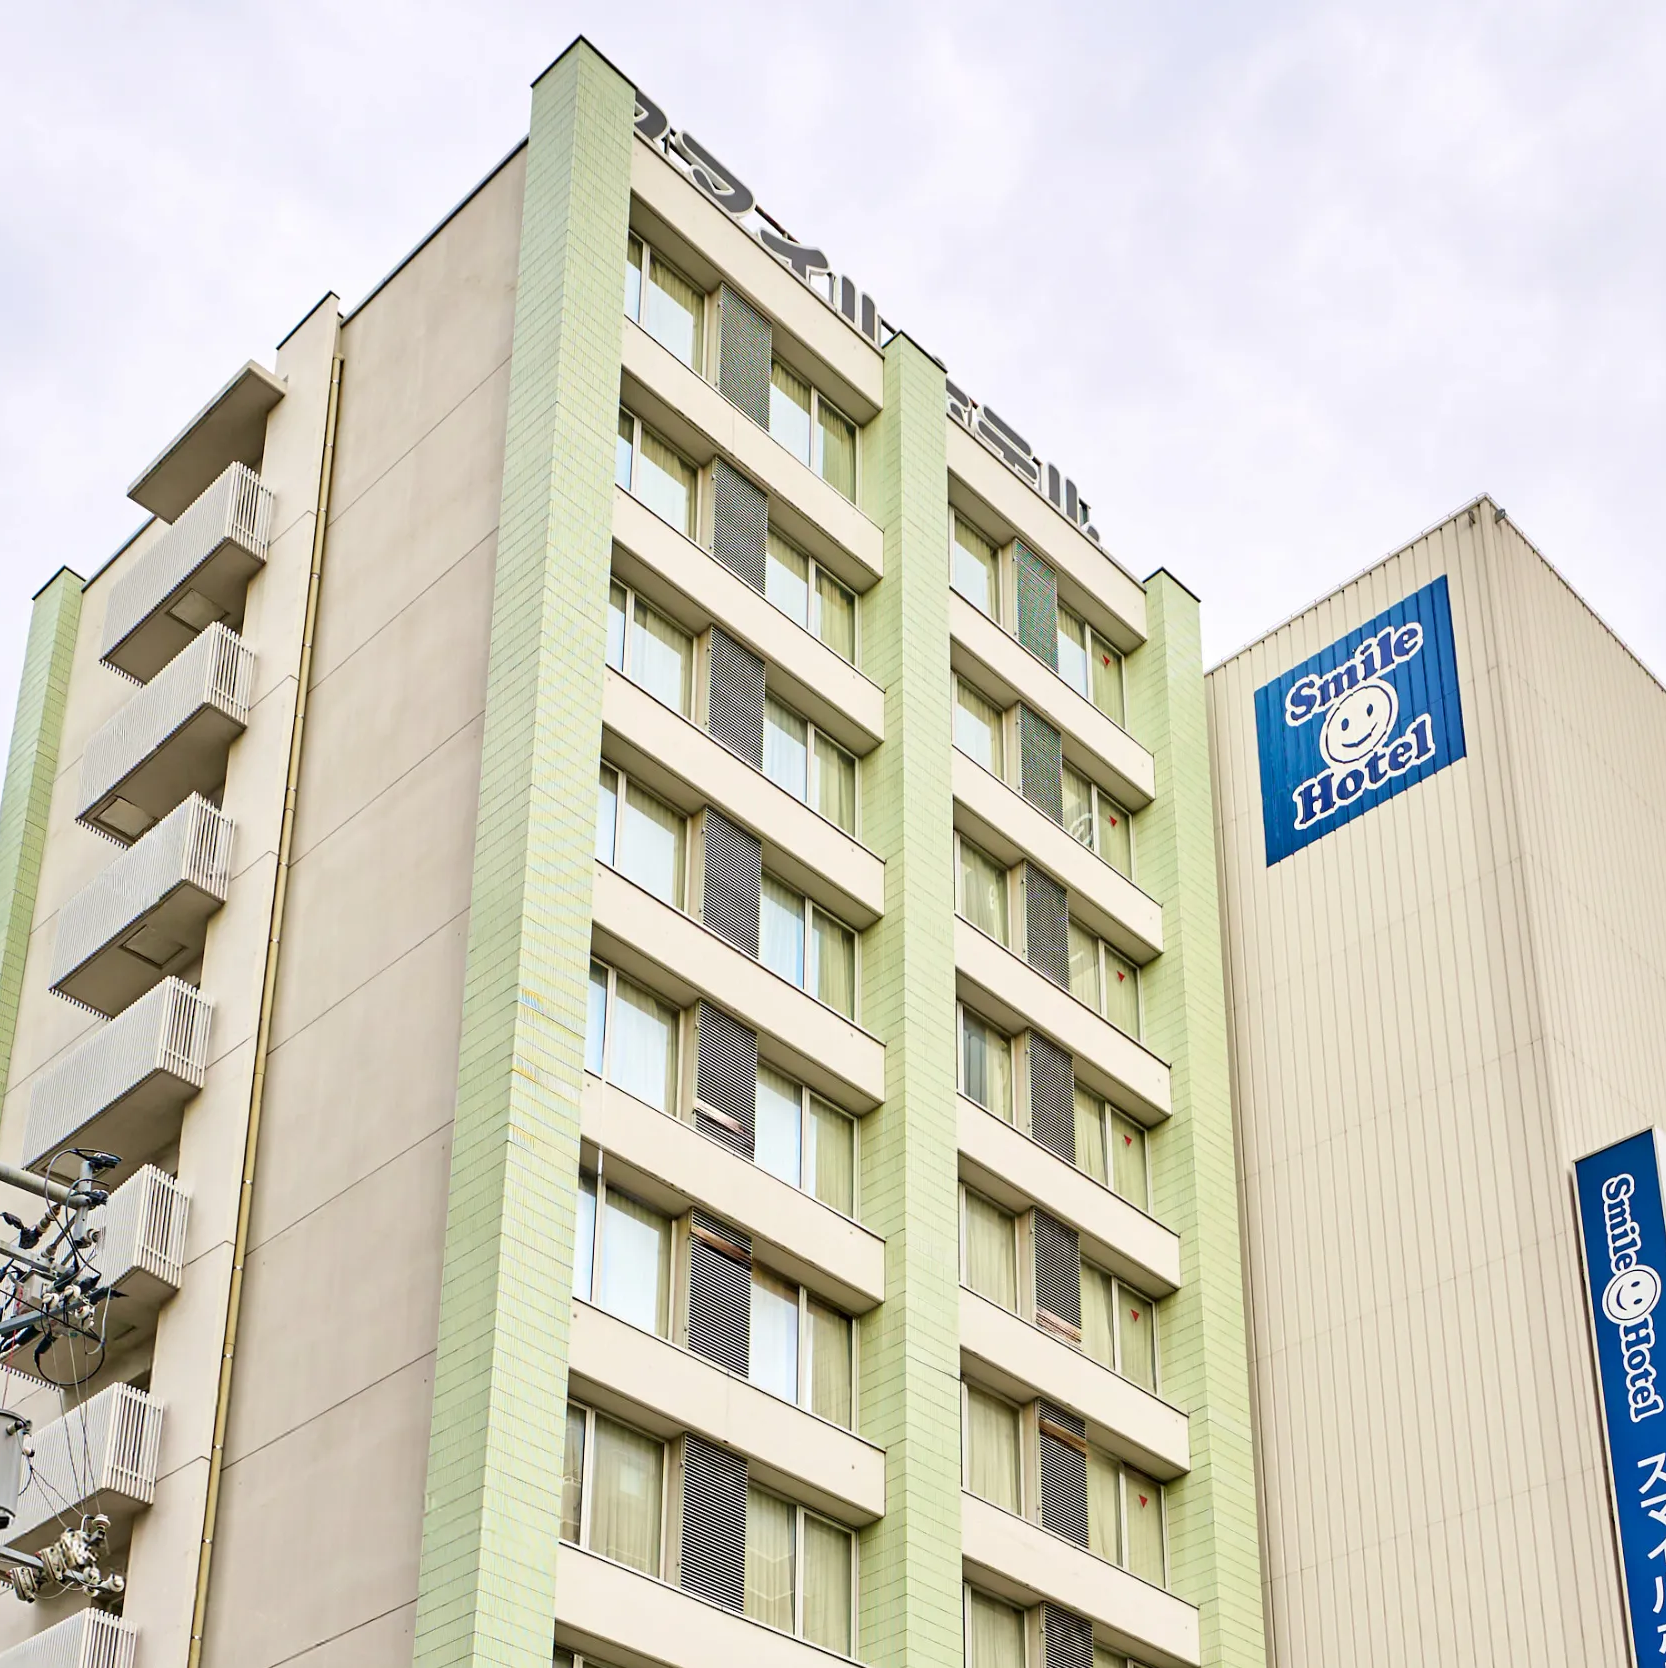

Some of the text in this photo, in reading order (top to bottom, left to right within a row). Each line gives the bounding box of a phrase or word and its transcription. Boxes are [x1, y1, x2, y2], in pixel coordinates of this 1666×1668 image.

[1286, 622, 1424, 726] Smile
[1294, 714, 1435, 830] Hotel
[1602, 1172, 1664, 1422] Smile Hotel
